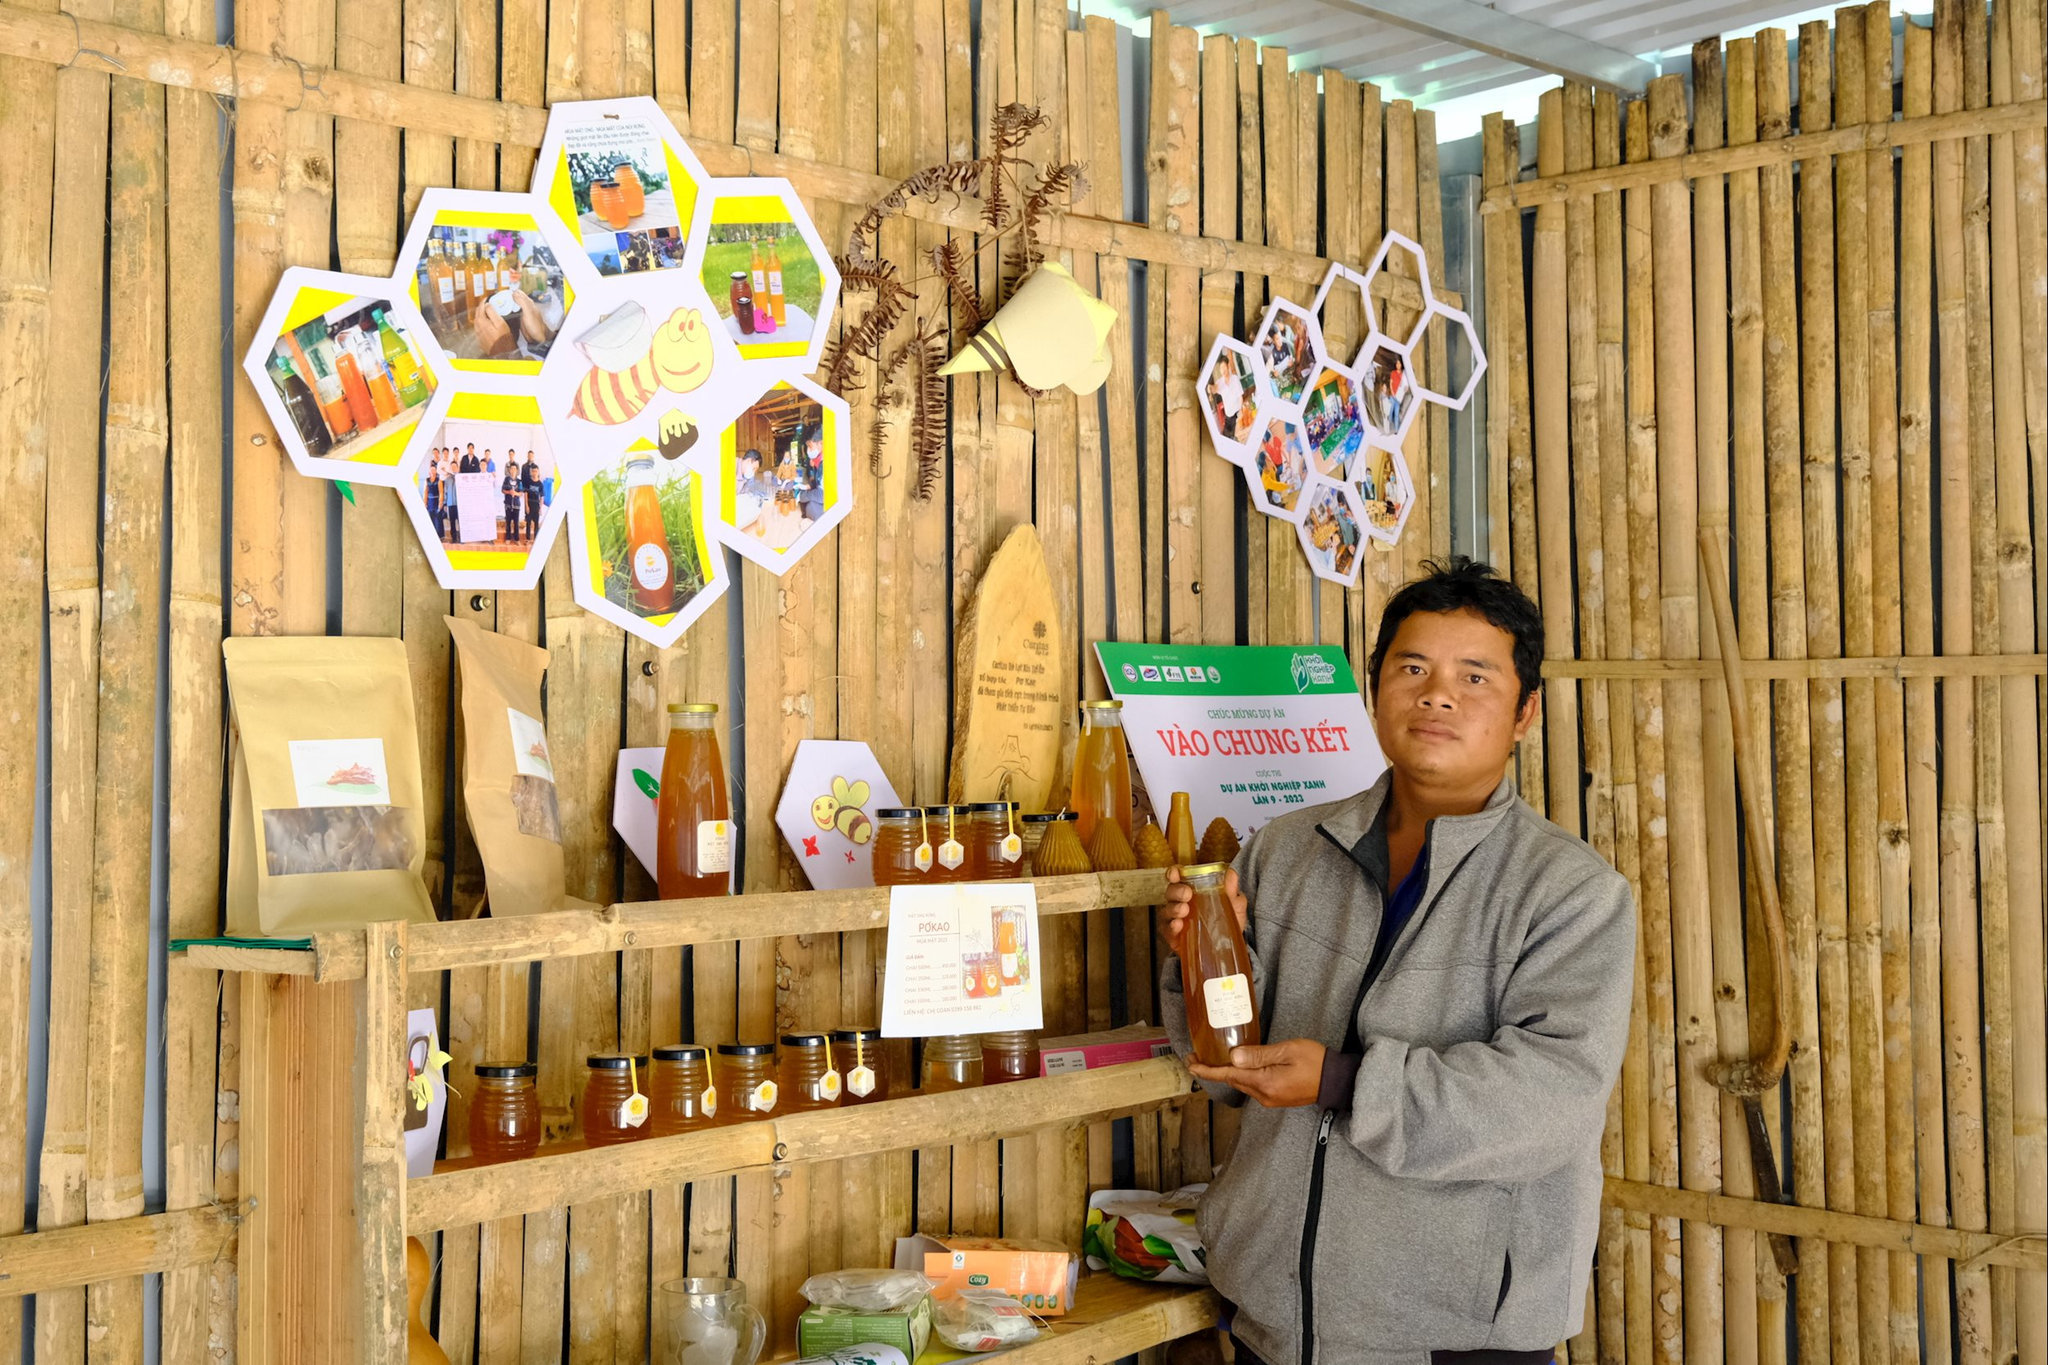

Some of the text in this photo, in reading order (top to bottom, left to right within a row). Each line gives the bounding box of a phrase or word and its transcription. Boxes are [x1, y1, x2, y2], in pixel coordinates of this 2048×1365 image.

[1207, 707, 1232, 720] CHÚC
[1231, 707, 1259, 719] MỪNG
[1258, 709, 1272, 720] DỰ
[1156, 719, 1351, 757] VÀO CHUNG KẾT
[1220, 783, 1233, 795] DỰ
[1271, 780, 1301, 793] NGHIỆP
[1302, 779, 1326, 790] XANH
[1270, 795, 1276, 804] 9
[1283, 794, 1304, 804] 2023
[969, 1276, 987, 1286] Cozy
